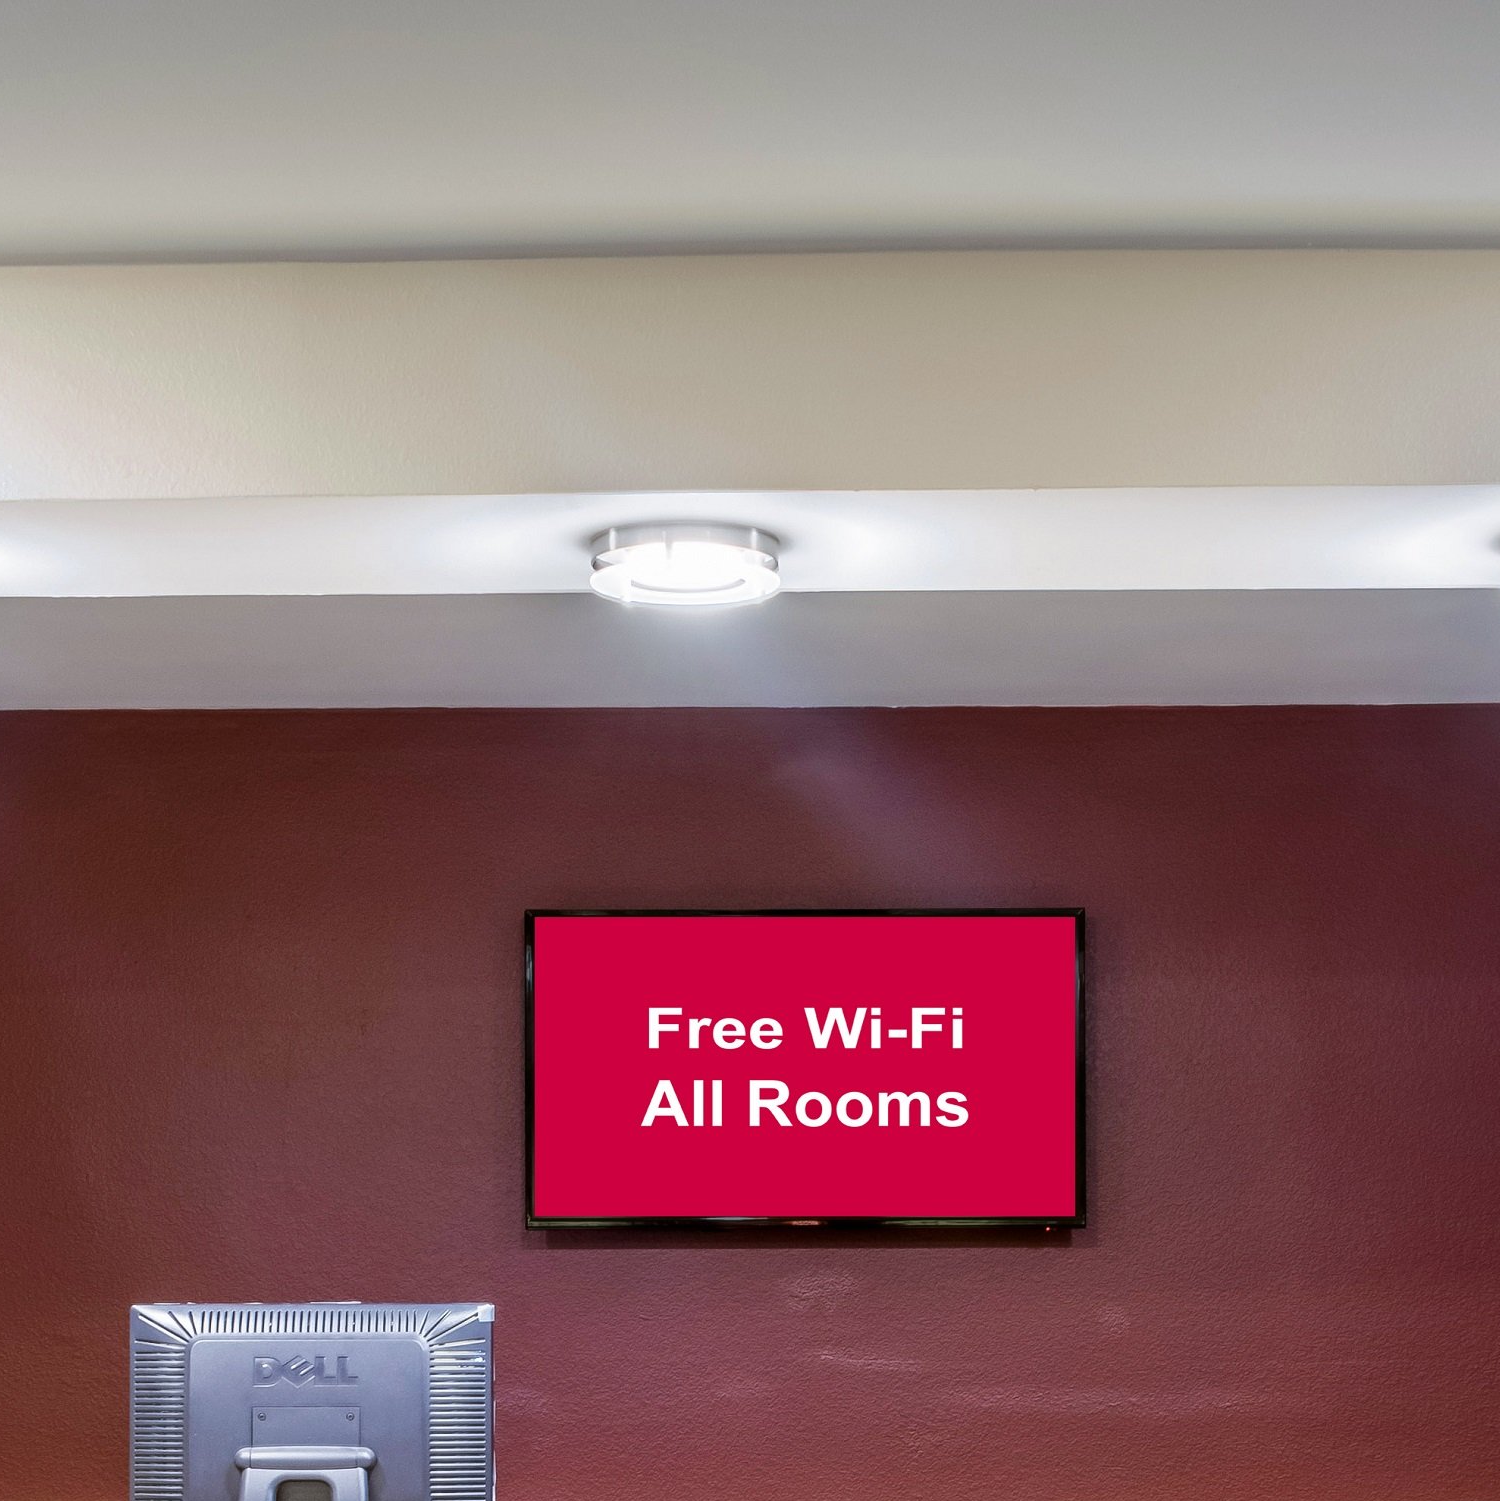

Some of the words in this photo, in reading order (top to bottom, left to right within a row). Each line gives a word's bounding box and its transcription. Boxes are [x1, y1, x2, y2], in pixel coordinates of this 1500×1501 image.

[648, 1007, 784, 1049] Free
[803, 1007, 963, 1049] Wi-Fi
[640, 1079, 723, 1127] All
[749, 1079, 969, 1128] Rooms
[252, 1354, 359, 1388] DELL
